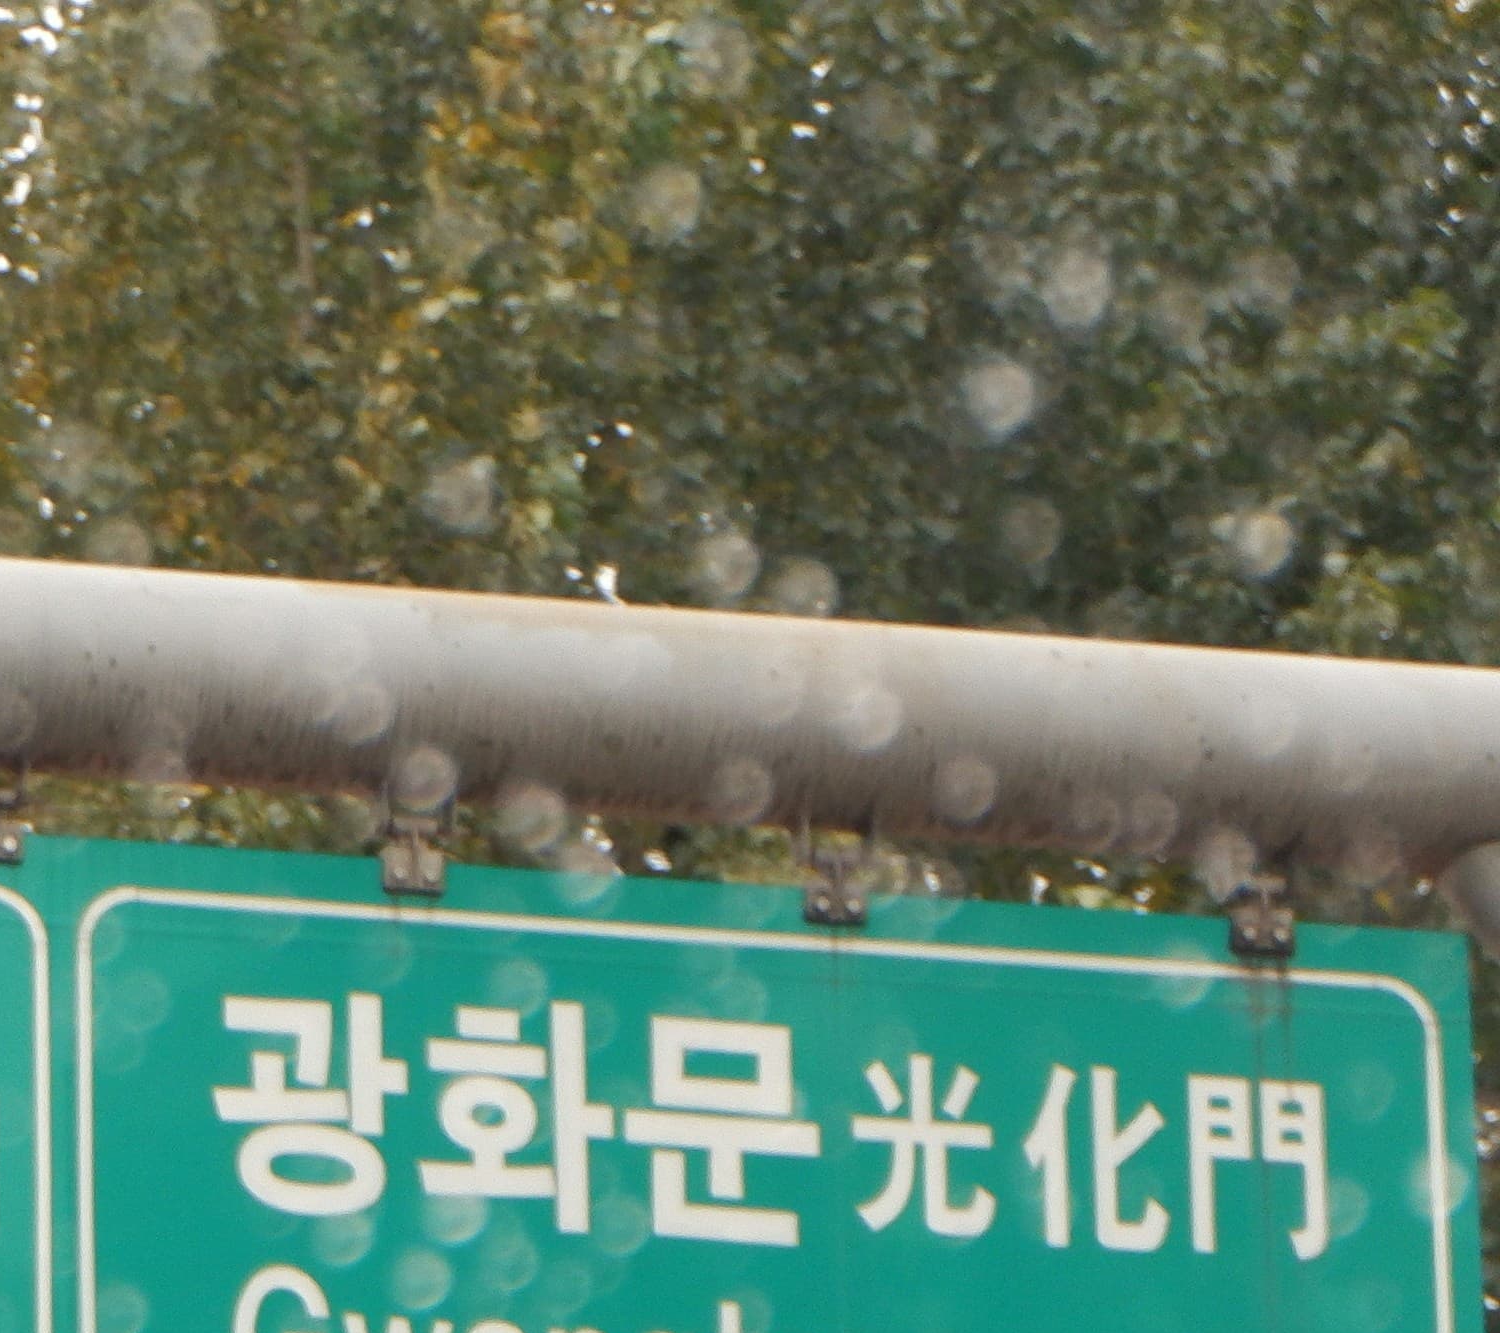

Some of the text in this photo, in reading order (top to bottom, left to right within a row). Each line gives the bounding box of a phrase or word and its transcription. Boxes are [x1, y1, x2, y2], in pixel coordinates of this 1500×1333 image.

[212, 991, 1330, 1260] 광화문 光化門
